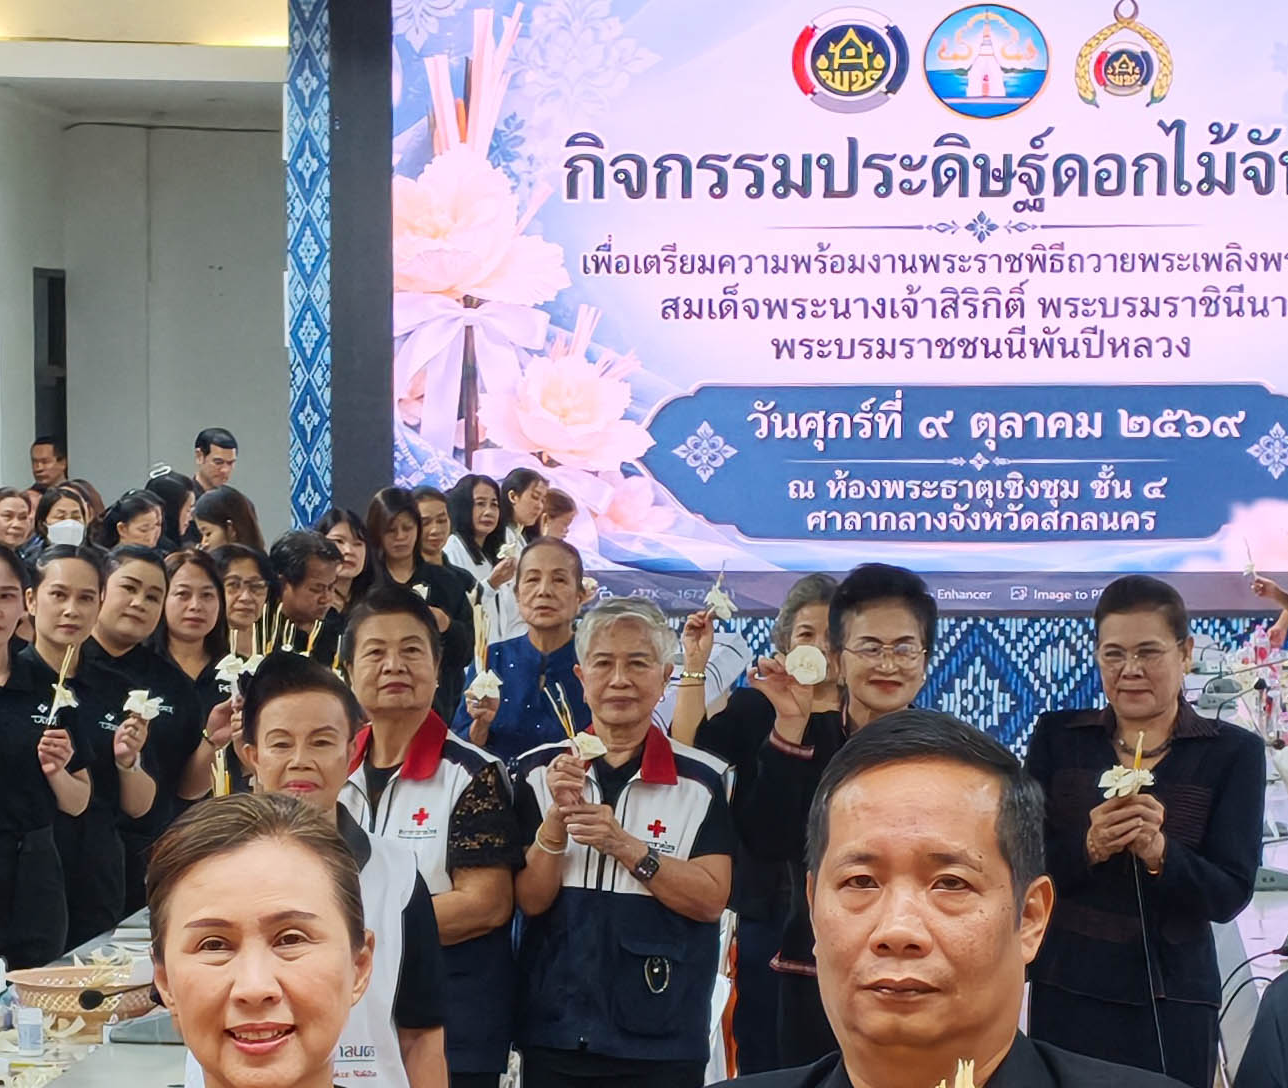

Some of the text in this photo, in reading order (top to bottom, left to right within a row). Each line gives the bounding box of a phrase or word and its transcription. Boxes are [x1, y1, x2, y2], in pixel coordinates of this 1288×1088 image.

[661, 280, 1029, 320] สมเด็จพระนางเจ้าสิริกิติ์
[771, 326, 1191, 360] พระบรมราชชนนีพันปีหลวง
[747, 390, 1247, 452] วันศุกร์ที่ ๙ ตุลาคม ๒๕๖๙
[788, 478, 815, 499] ณ
[826, 470, 1079, 507] ห้องพระธาตุเชิงชุม
[1091, 464, 1132, 499] ชั้น
[806, 503, 1156, 532] ศาลากลางจังหวัดสกลนคร
[937, 588, 992, 600] Enhancer
[1033, 588, 1072, 602] Image
[1074, 589, 1088, 600] to
